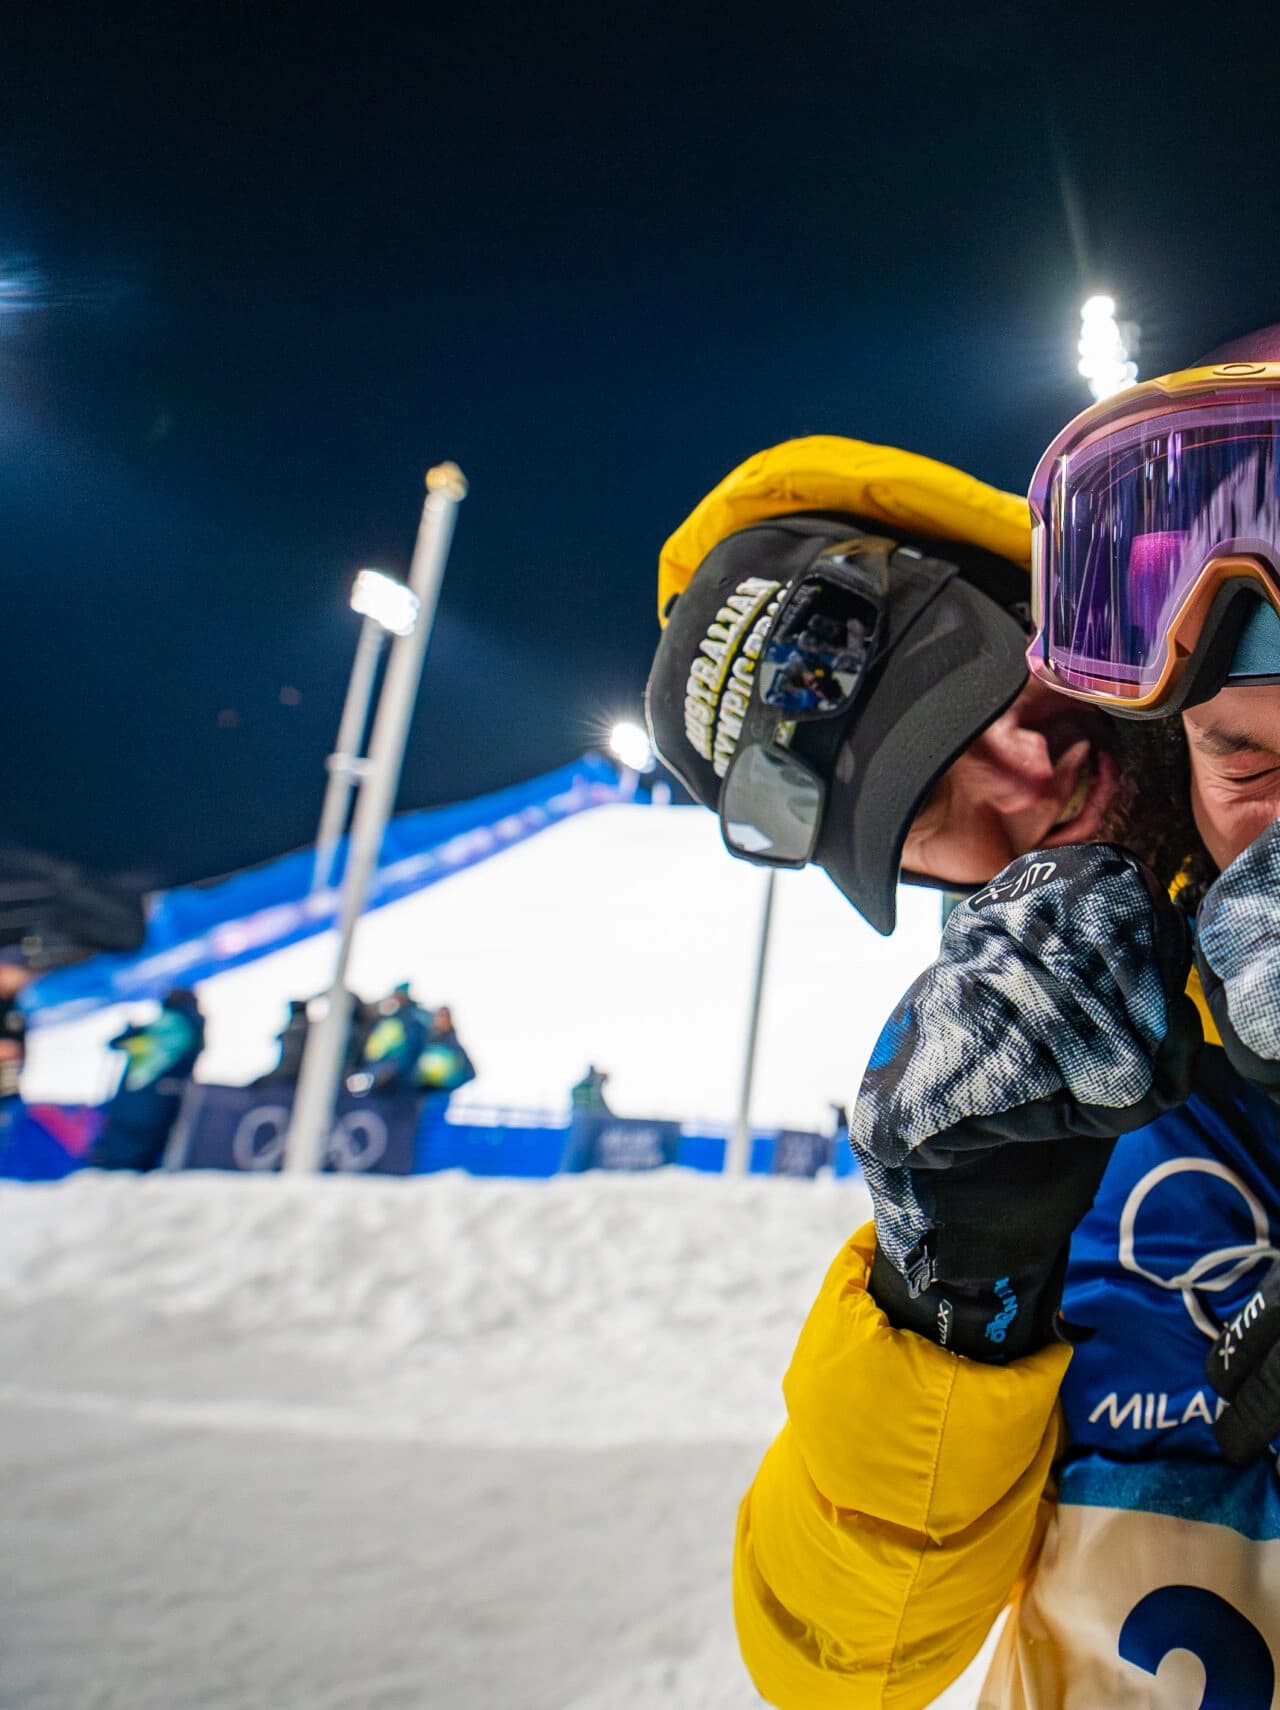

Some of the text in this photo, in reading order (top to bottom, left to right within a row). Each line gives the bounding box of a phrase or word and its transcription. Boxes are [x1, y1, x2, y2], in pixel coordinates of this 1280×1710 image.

[684, 576, 781, 761] AUSTRALIAN
[974, 861, 1057, 904] XTM
[1218, 1291, 1265, 1370] XTM
